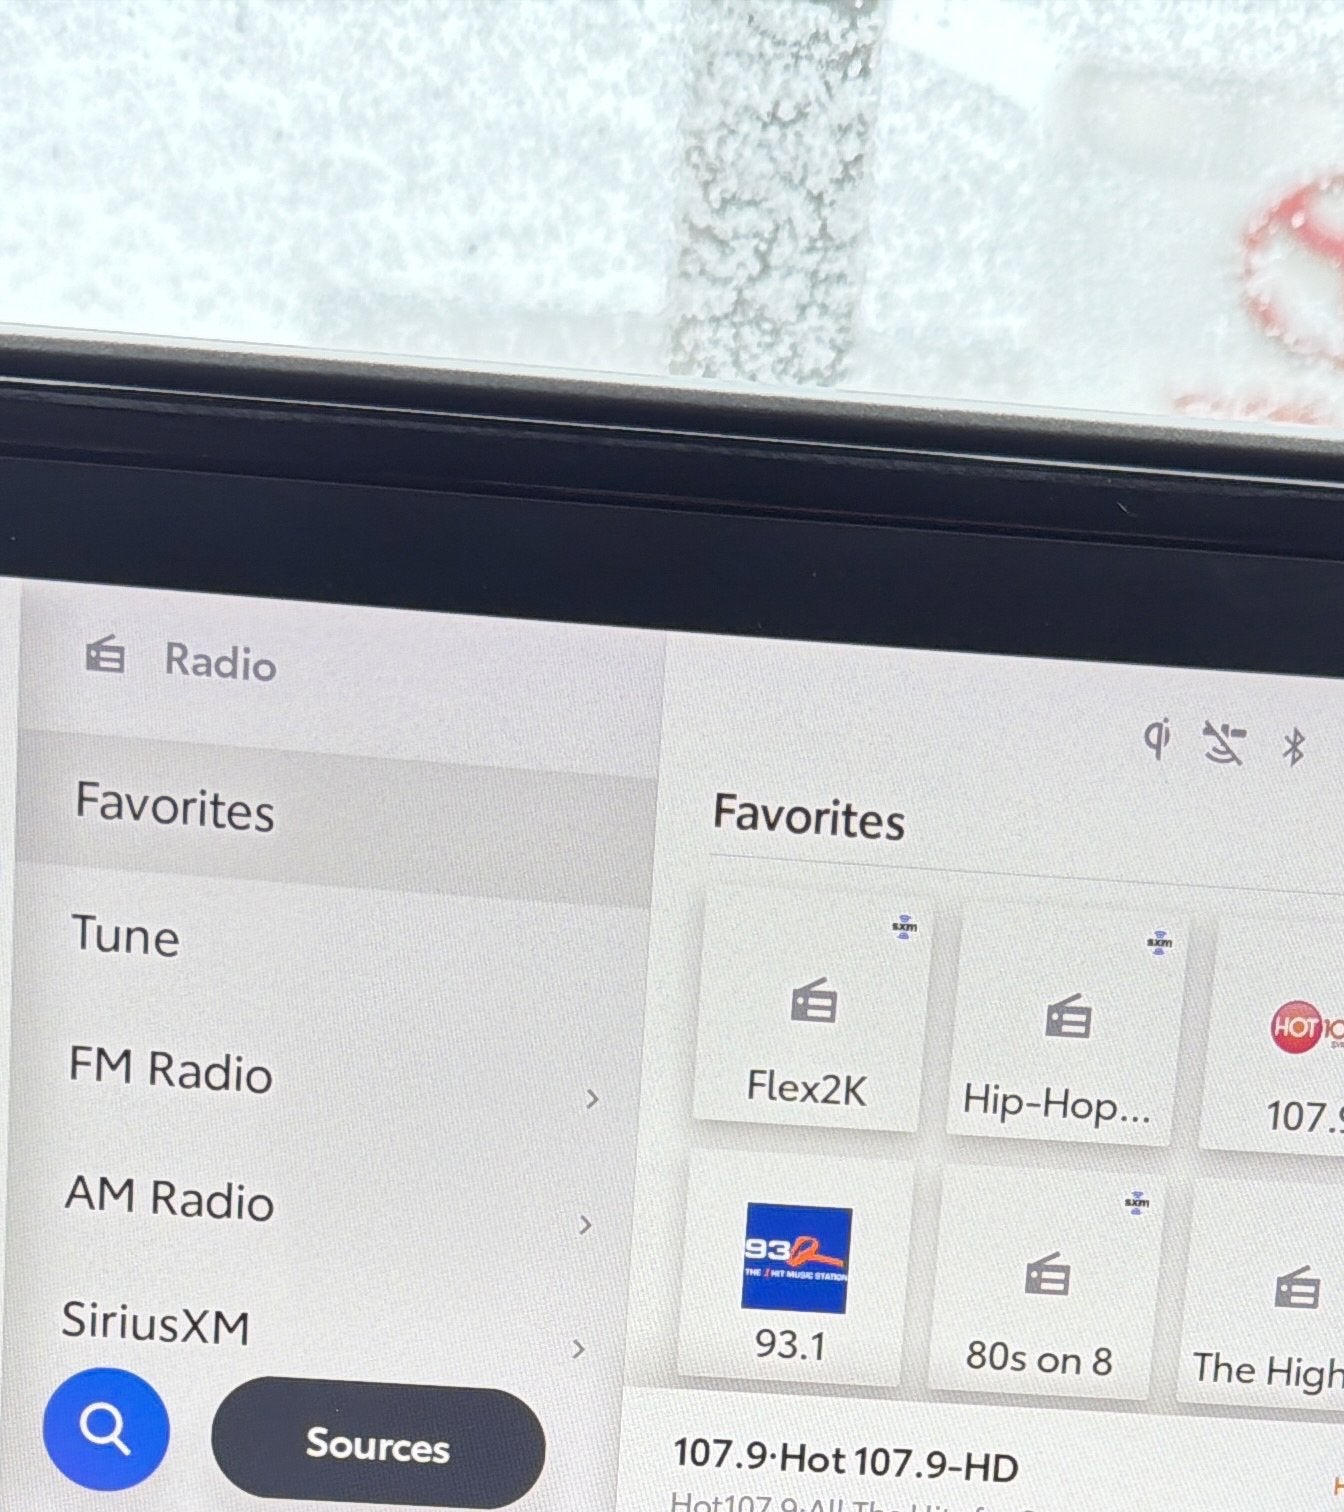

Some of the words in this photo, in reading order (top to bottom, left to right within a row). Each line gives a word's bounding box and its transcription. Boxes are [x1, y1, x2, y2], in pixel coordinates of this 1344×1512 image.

[165, 640, 278, 683] Radio
[76, 779, 275, 834] Favorites
[713, 791, 906, 842] Favorites
[70, 912, 181, 959] Tune
[1274, 1016, 1320, 1039] HOT
[69, 1044, 133, 1085] FM
[148, 1049, 274, 1096] Radio
[747, 1068, 868, 1108] Flex2K
[963, 1081, 1152, 1129] Hip-Hop...
[64, 1174, 135, 1214] AM
[151, 1178, 275, 1223] Radio
[745, 1268, 762, 1277] THE
[771, 1269, 785, 1279] HIT
[786, 1270, 814, 1281] MUSIC
[814, 1271, 848, 1282] STATION
[61, 1299, 250, 1347] SiriusXM
[754, 1327, 825, 1362] 93.1
[965, 1339, 1028, 1373] 80s
[1036, 1351, 1083, 1376] on
[1091, 1345, 1114, 1378] 8
[1192, 1350, 1257, 1385] The
[305, 1425, 452, 1465] Sources
[855, 1445, 1020, 1484] 107.9-HD
